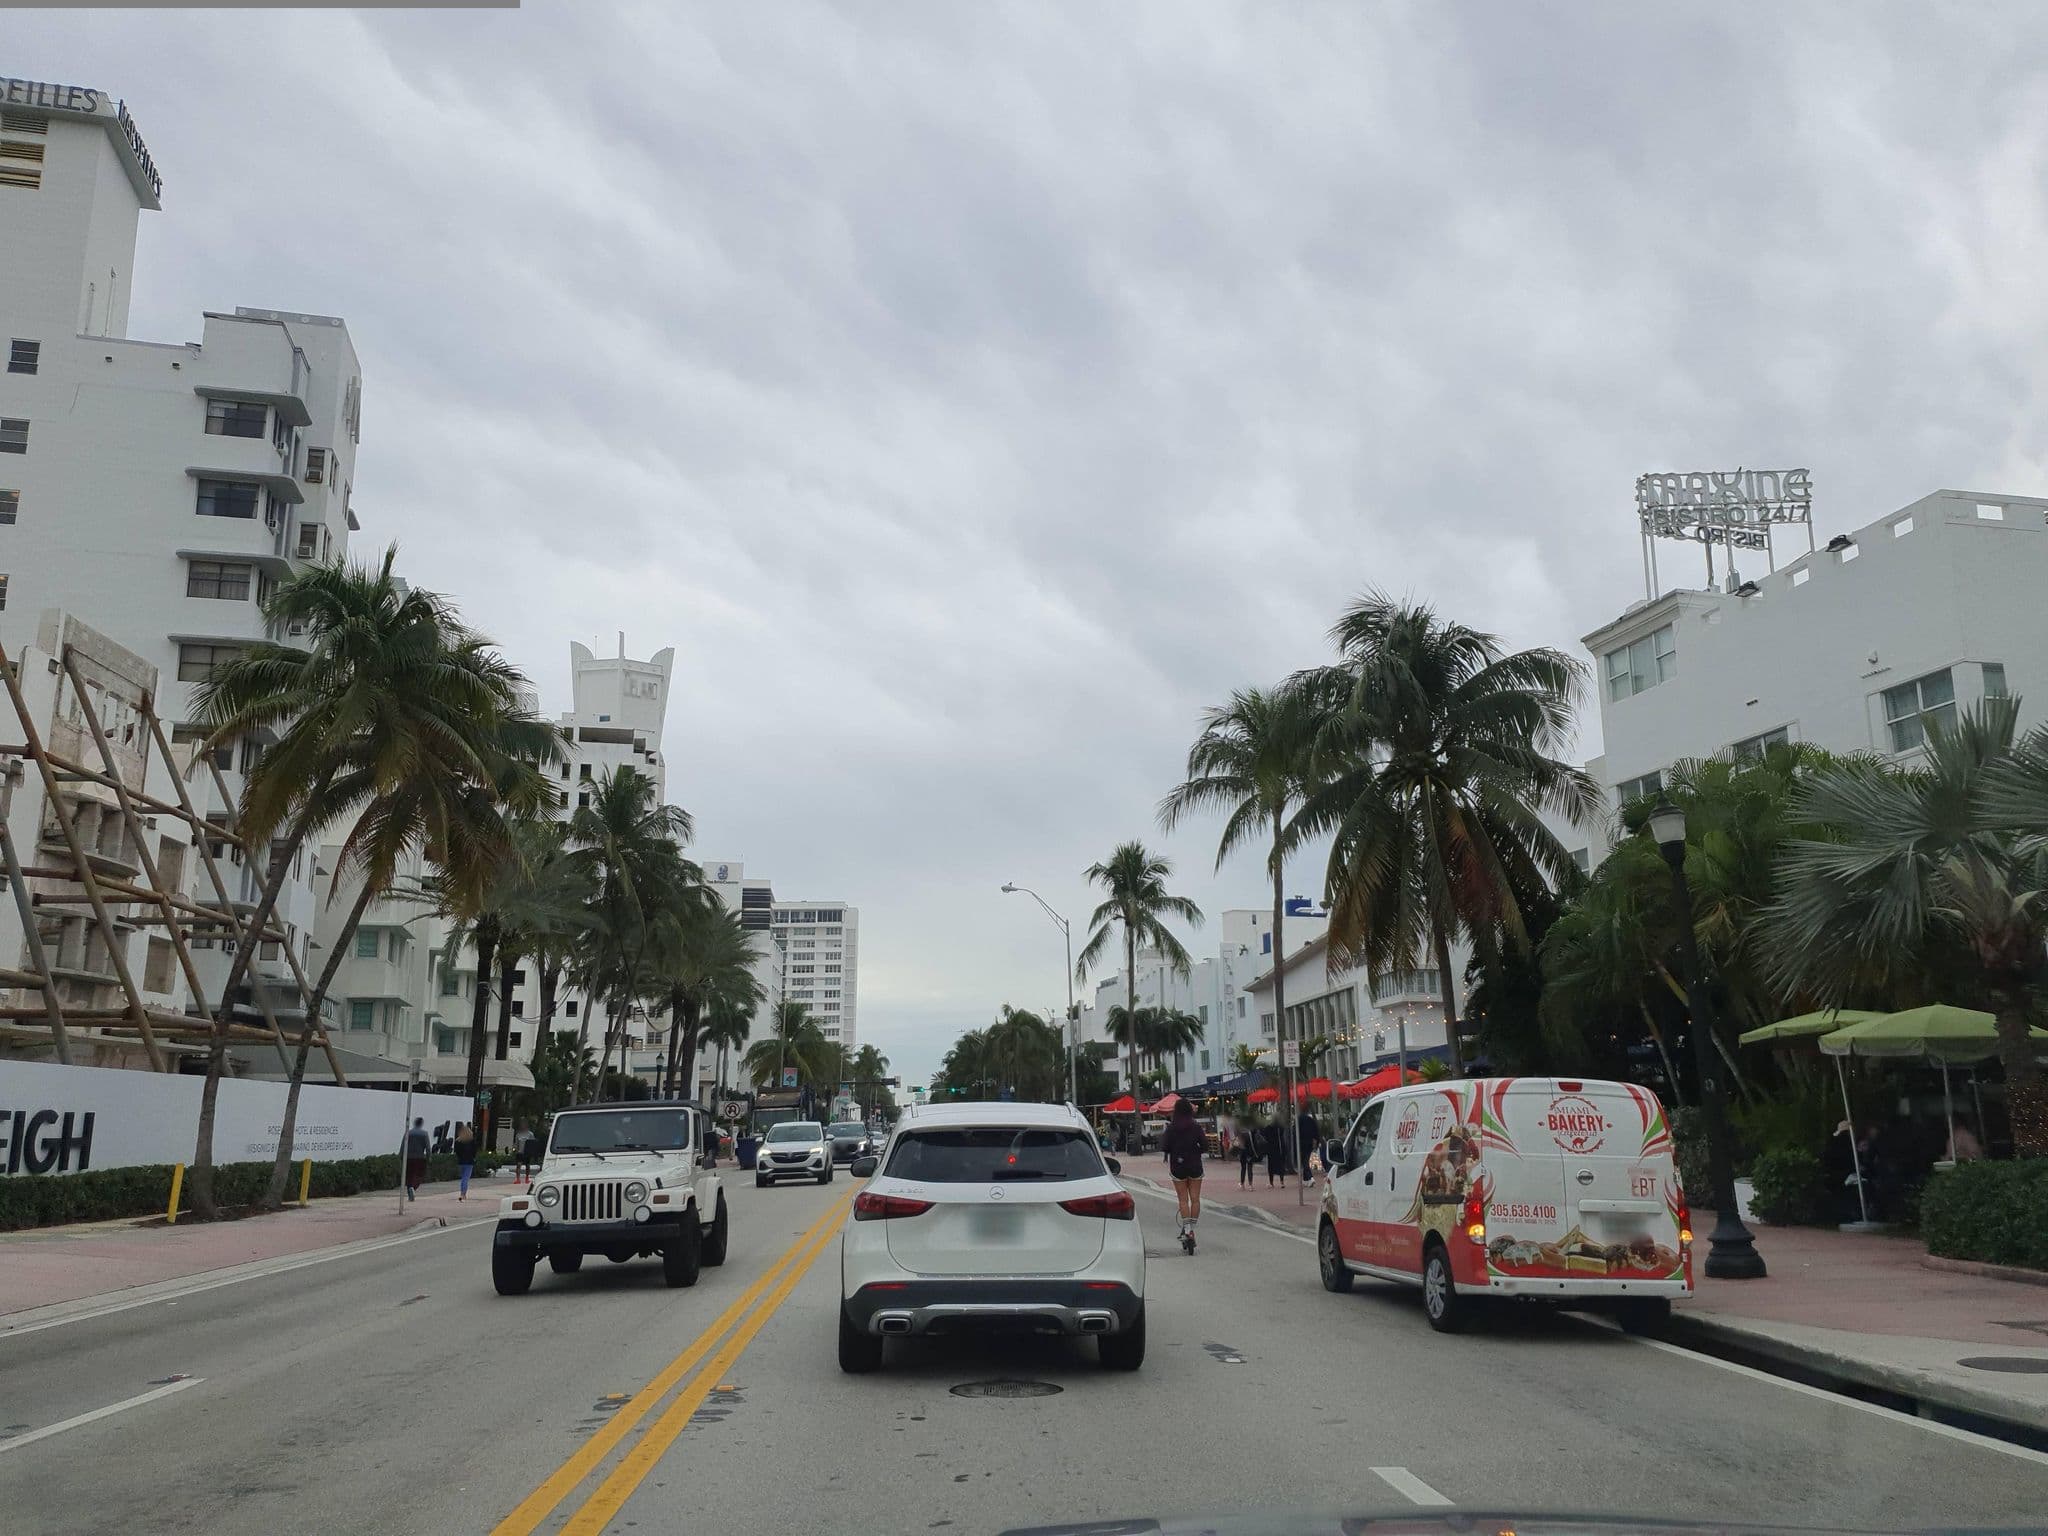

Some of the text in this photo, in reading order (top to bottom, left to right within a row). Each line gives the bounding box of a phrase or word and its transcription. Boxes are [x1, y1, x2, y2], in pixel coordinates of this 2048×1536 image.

[0, 77, 99, 113] EILLES
[1548, 1113, 1604, 1132] BAKERY
[1631, 1177, 1656, 1197] EBT
[1490, 1203, 1556, 1219] 305.638.4100
